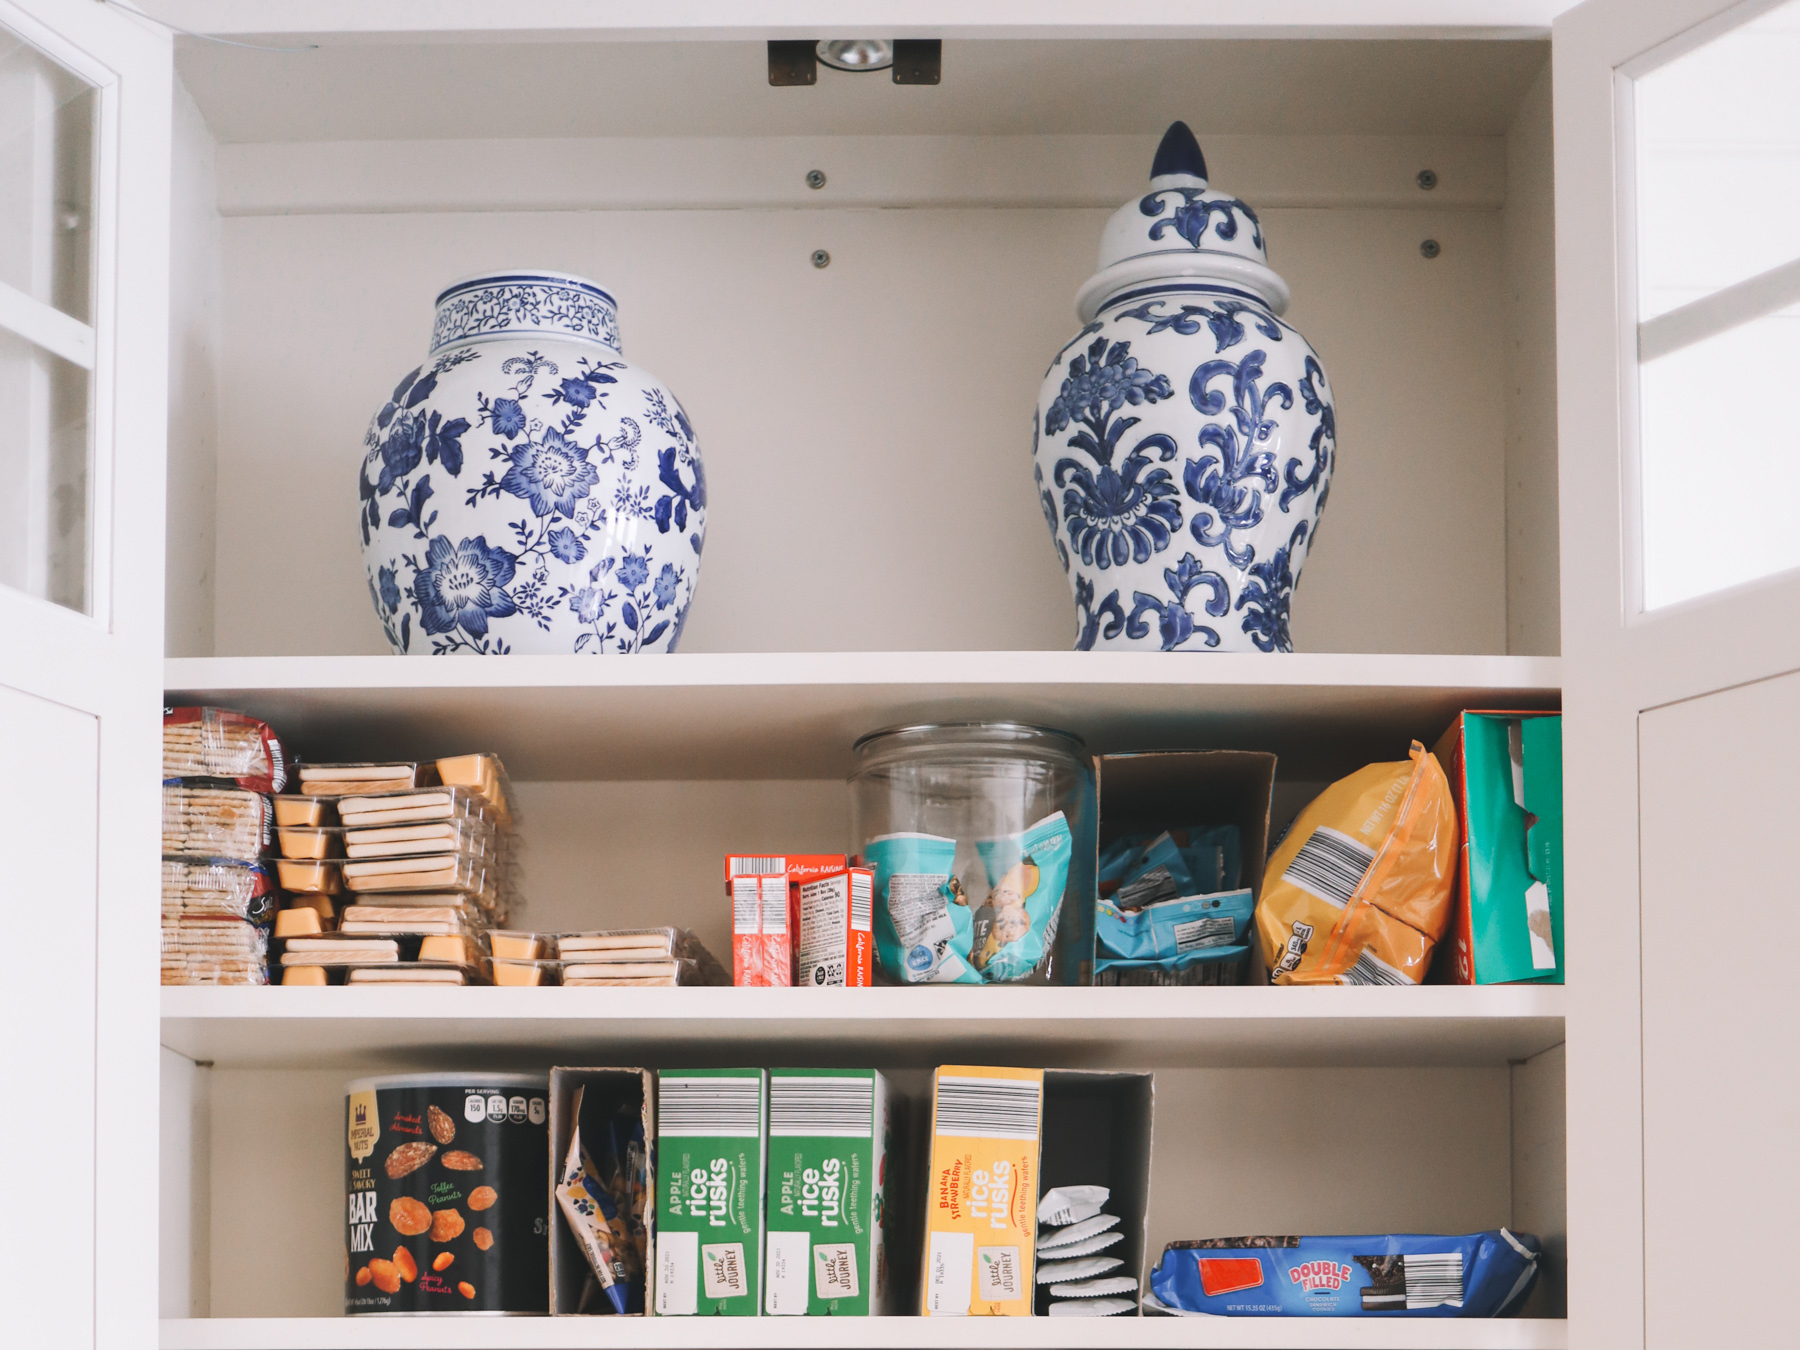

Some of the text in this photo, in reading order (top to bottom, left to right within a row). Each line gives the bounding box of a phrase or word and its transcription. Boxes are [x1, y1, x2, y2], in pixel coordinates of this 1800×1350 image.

[787, 864, 819, 875] California
[470, 1104, 480, 1112] 150
[349, 1191, 378, 1224] BAR
[669, 1172, 683, 1216] APPLE
[686, 1168, 708, 1217] rice
[706, 1158, 728, 1227] rusks
[737, 1153, 751, 1234] gentle teething wafers
[780, 1172, 794, 1216] APPLE
[797, 1168, 820, 1217] rice
[818, 1158, 840, 1227] rusks
[850, 1153, 864, 1235] gentle teething wafers
[940, 1169, 951, 1209] BANANA
[950, 1159, 963, 1220] STRAWBERRY
[966, 1169, 990, 1218] rice
[988, 1160, 1011, 1230] rusks
[1019, 1156, 1031, 1238] gentle teething wafers
[351, 1223, 374, 1253] MIX
[714, 1257, 727, 1284] little
[725, 1249, 740, 1290] JOURNEY
[825, 1258, 839, 1284] little
[837, 1250, 852, 1290] JOURNEY
[989, 1260, 1003, 1287] little
[1001, 1253, 1015, 1293] JOURNEY
[1289, 1261, 1352, 1284] DOUBLE
[1302, 1276, 1341, 1292] FILLED
